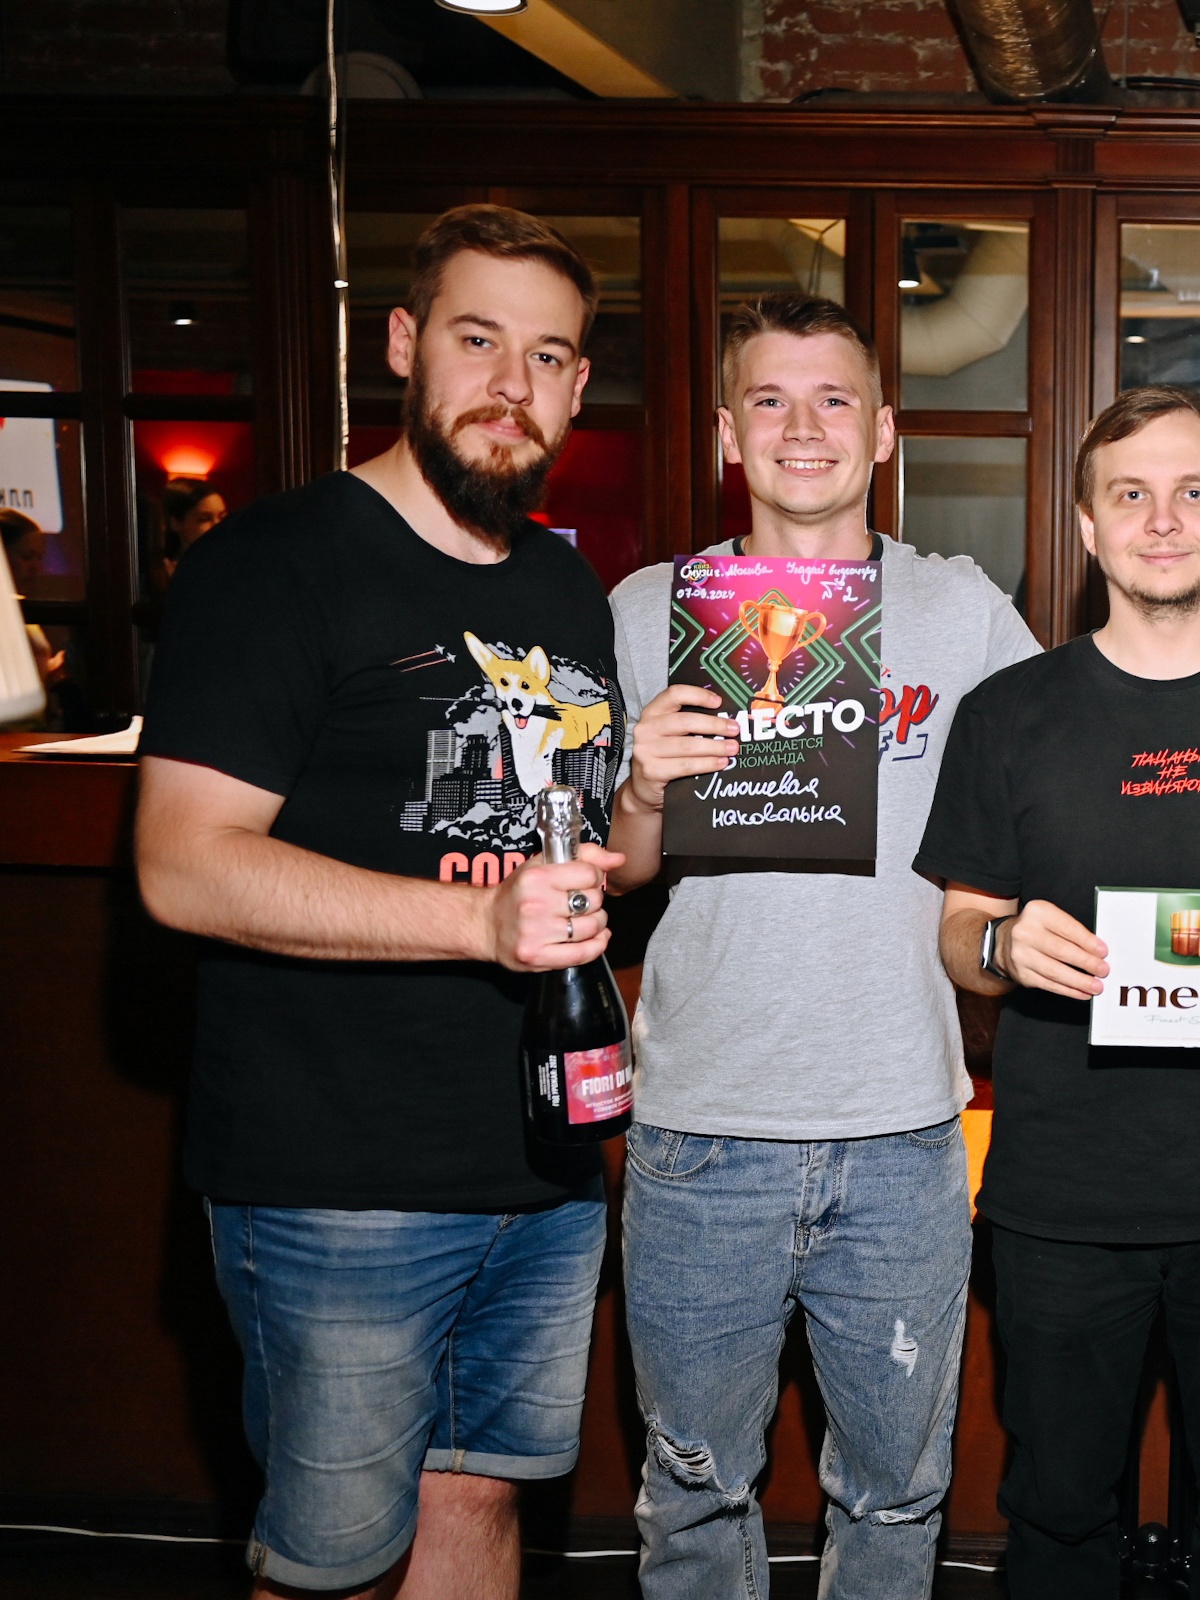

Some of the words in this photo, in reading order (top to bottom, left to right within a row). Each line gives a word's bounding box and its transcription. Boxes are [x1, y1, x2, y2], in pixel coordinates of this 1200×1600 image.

[680, 564, 713, 580] Смузи
[737, 736, 824, 756] ГРАЖДАЕТСЯ
[738, 751, 806, 769] КОМАНДА
[1156, 764, 1189, 780] НЕ
[581, 1074, 614, 1096] FIORI
[616, 1070, 626, 1088] DI
